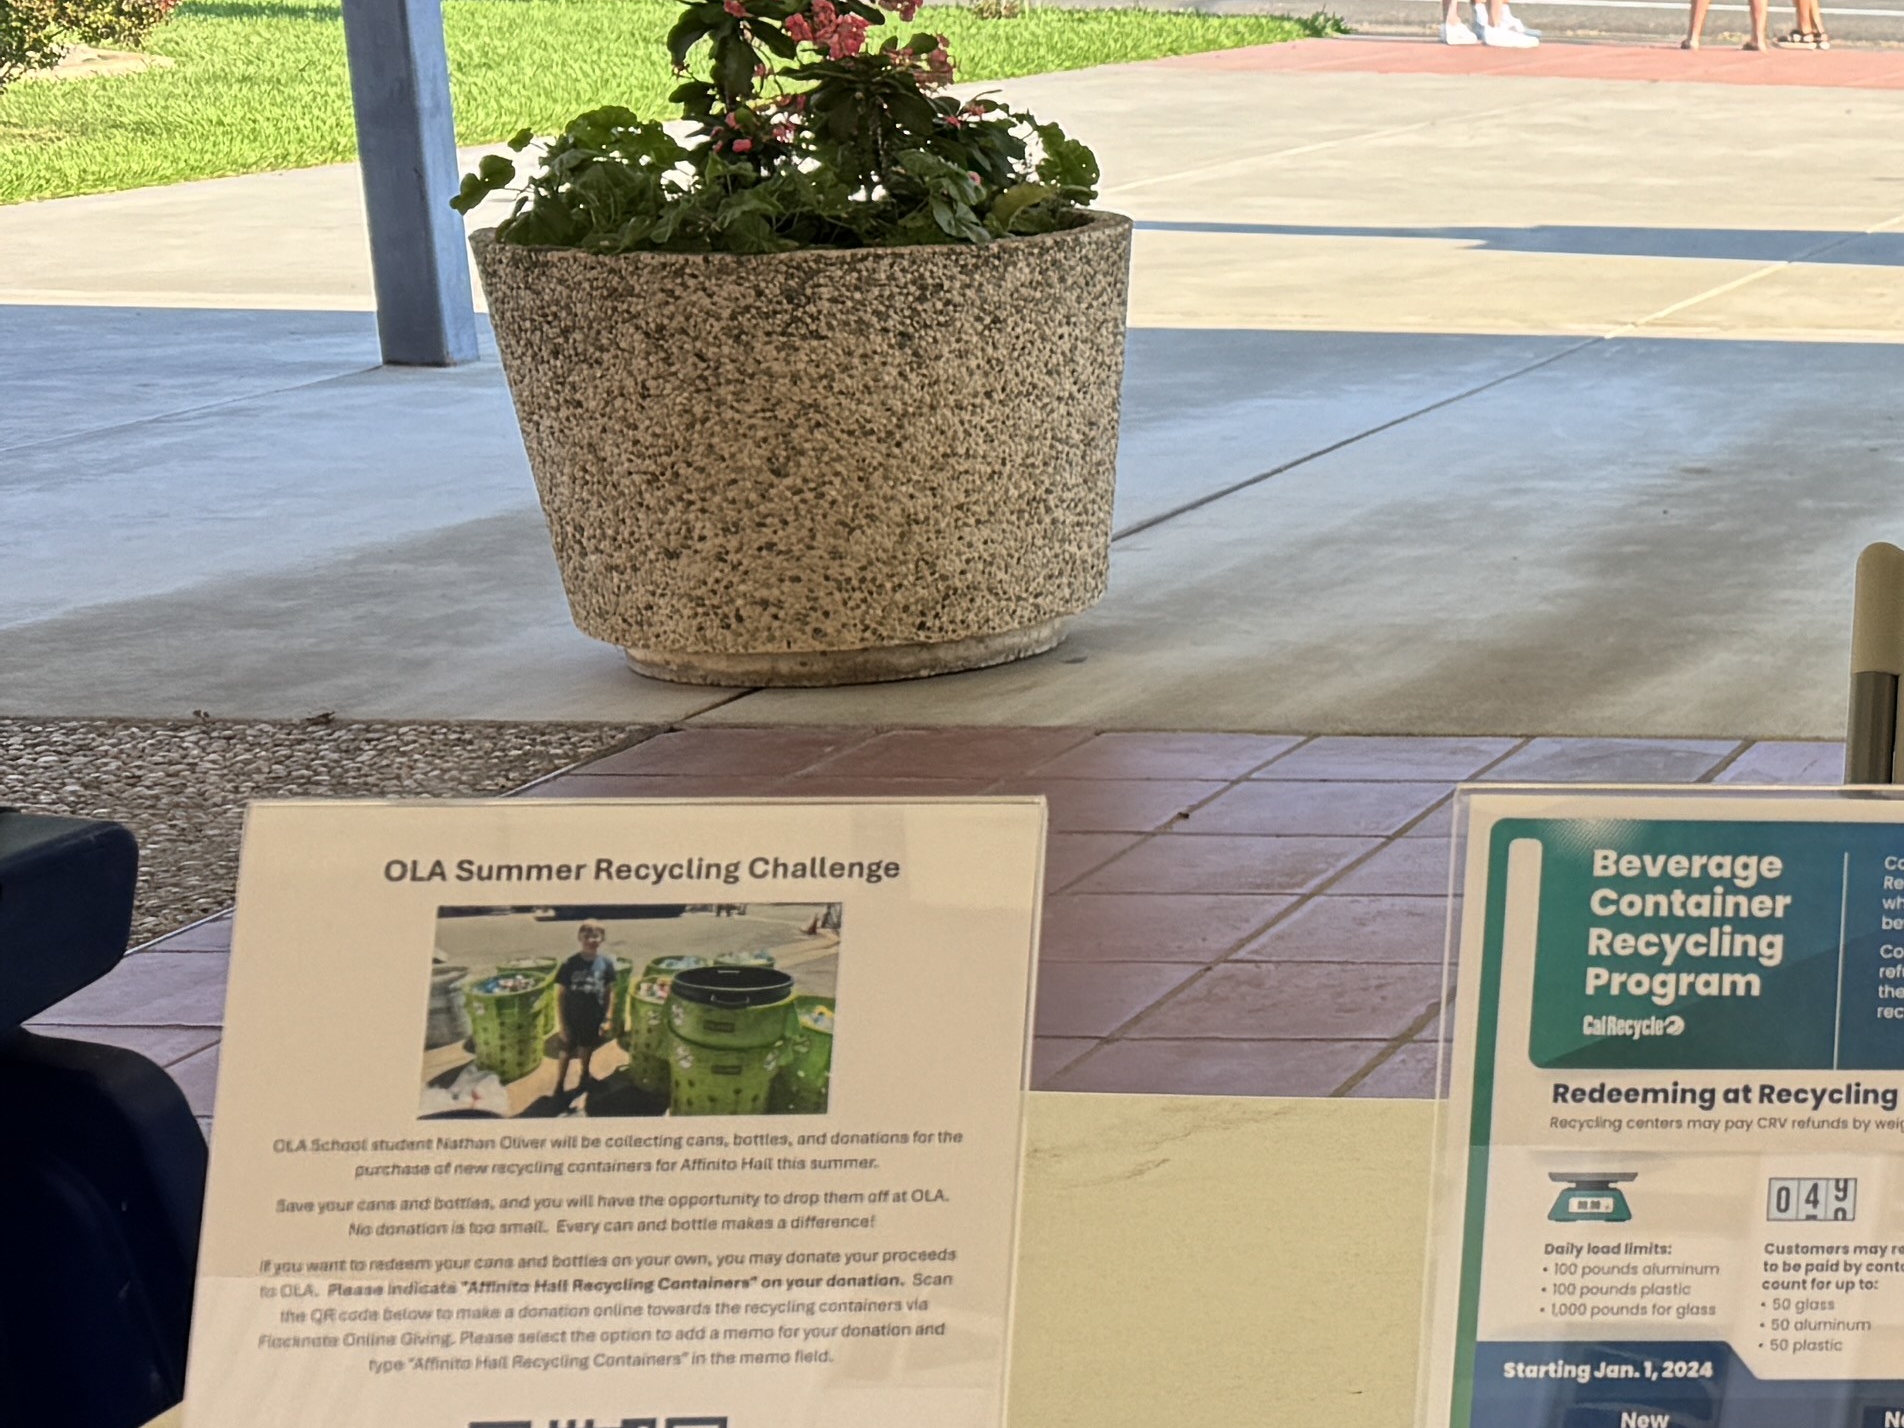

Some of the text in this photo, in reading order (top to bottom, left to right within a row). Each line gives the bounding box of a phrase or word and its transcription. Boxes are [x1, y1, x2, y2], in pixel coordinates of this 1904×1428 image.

[384, 856, 900, 885] OLA Summer Recycling Challenge
[1592, 848, 1783, 887] Beverage
[1590, 888, 1791, 917] Container
[1588, 926, 1783, 966] Recycling
[1585, 966, 1760, 1005] Program
[1552, 1080, 1715, 1111] Redeeming
[1722, 1084, 1752, 1103] at
[1758, 1081, 1898, 1111] Recycling
[1544, 1242, 1671, 1259] Daily load limits:
[1554, 1262, 1719, 1278] 100 pounds aluminum
[1772, 1297, 1834, 1314] 50 glass
[1503, 1359, 1712, 1383] Starting Jan. 1, 2024
[1620, 1411, 1669, 1428] New
